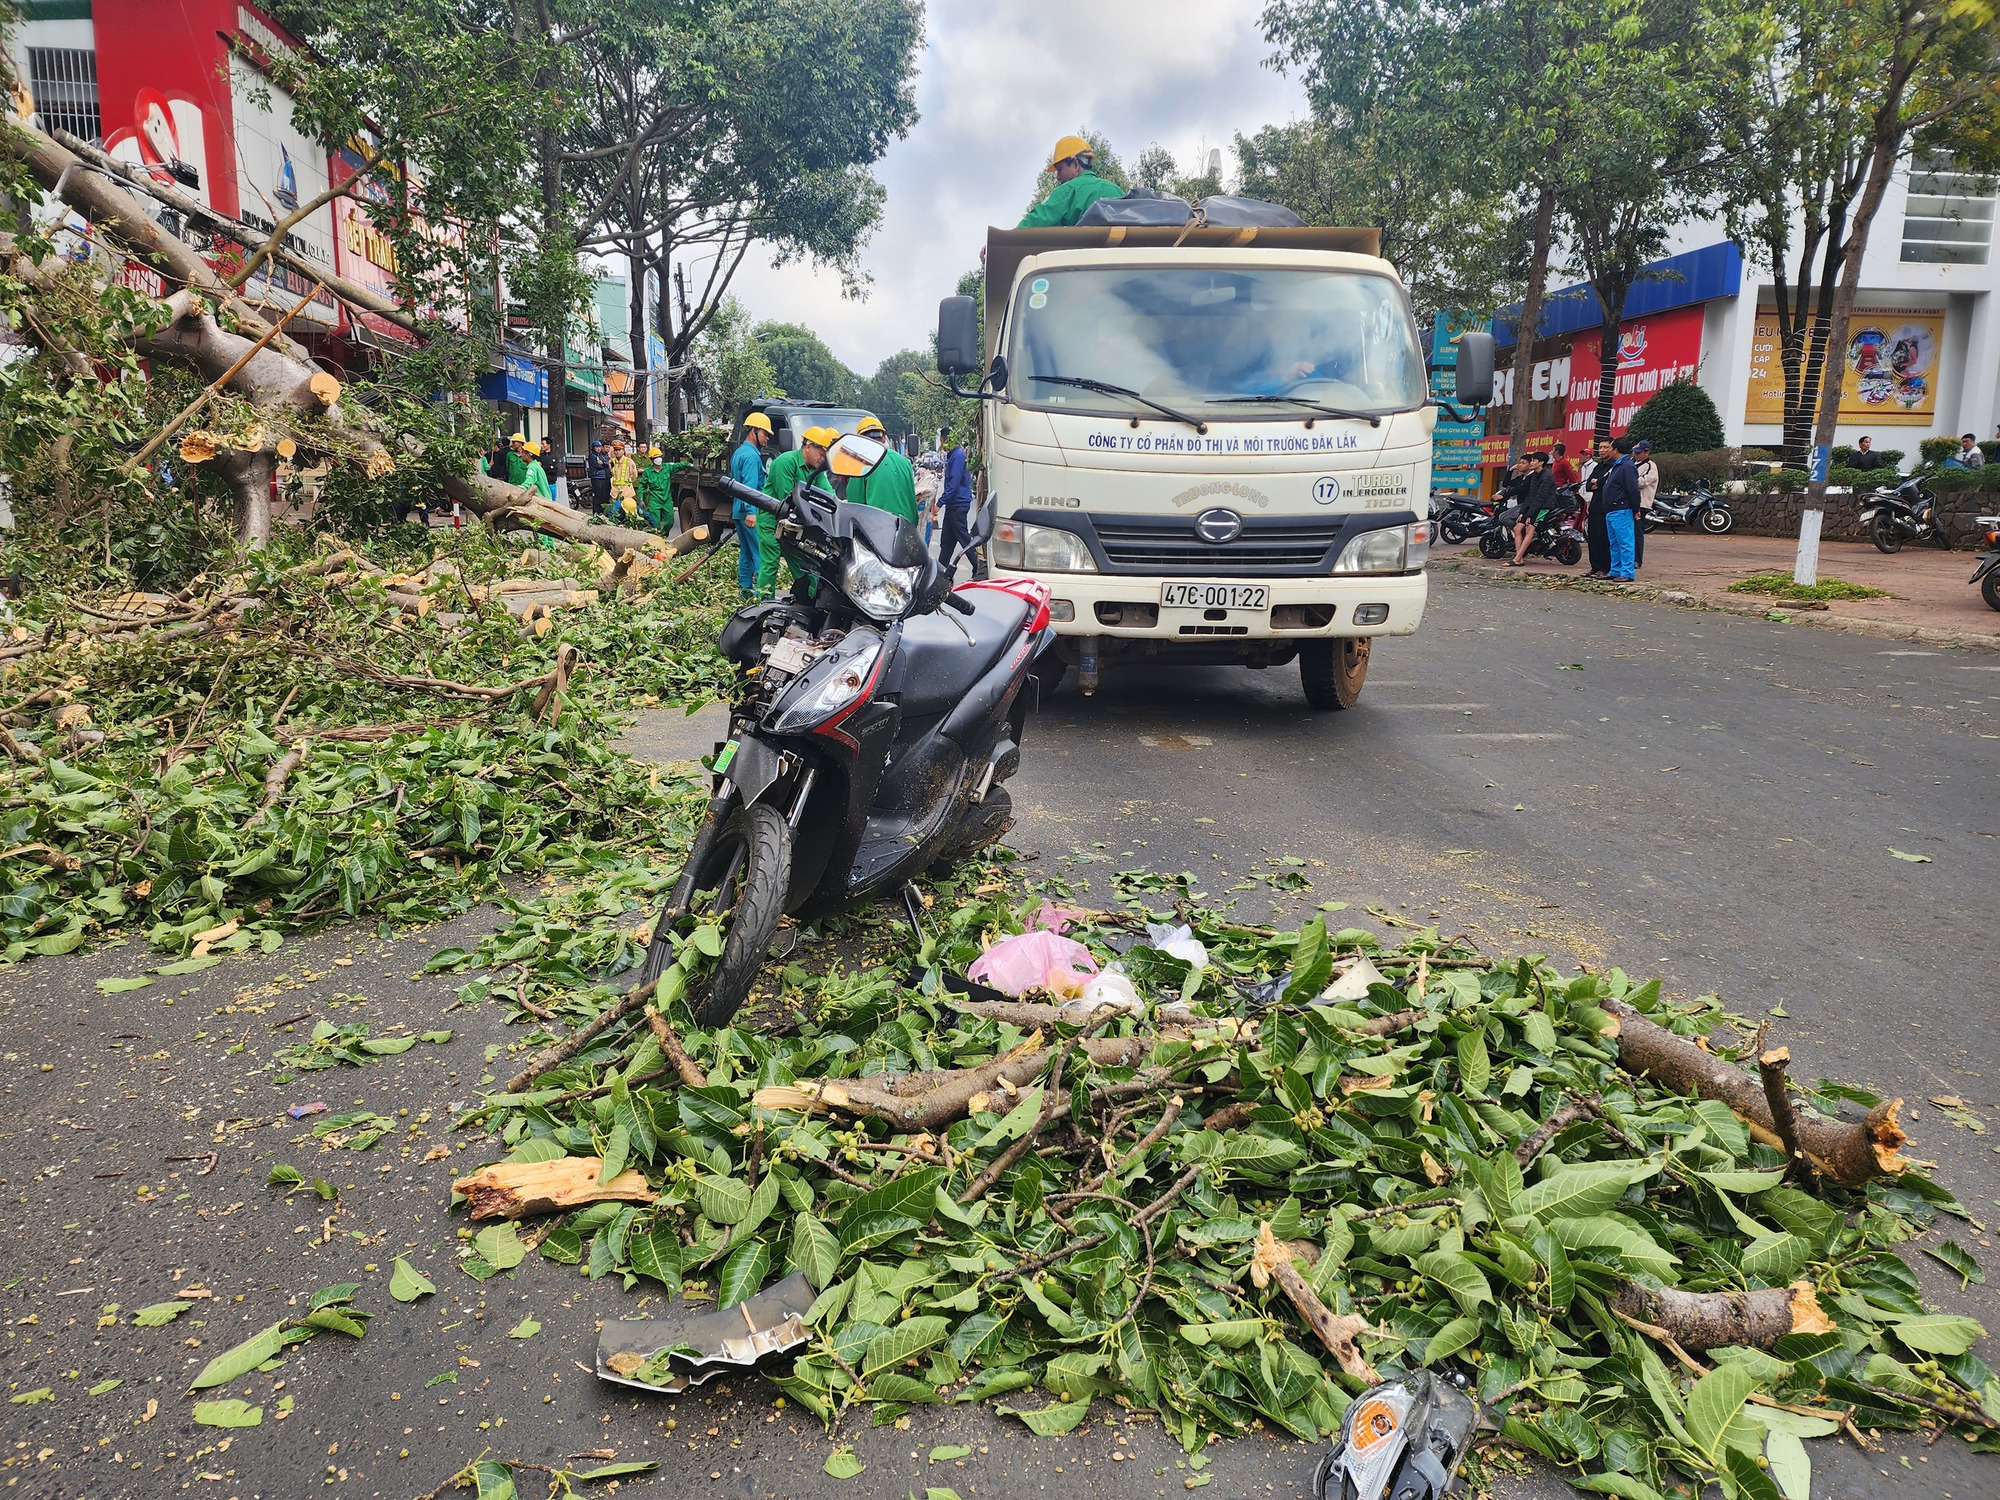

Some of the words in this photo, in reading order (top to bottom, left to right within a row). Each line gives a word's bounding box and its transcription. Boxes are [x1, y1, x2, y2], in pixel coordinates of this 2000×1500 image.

[1754, 324, 1774, 337] IÊU
[1532, 357, 1571, 401] EM
[1621, 373, 1636, 395] VUI
[1637, 369, 1659, 392] CHƠI
[1584, 410, 1596, 430] NH
[1088, 432, 1117, 448] CÔNG
[1120, 436, 1133, 450] TY
[1137, 432, 1152, 450] CỔ
[1155, 433, 1184, 451] PHẦN
[1187, 435, 1201, 451] ĐÔ
[1205, 439, 1223, 454] THỊ
[1226, 436, 1240, 452] VÀ
[1244, 436, 1263, 451] MÔI
[1267, 435, 1309, 451] TRƯỜNG
[1312, 432, 1333, 450] ĐẮK
[1337, 430, 1357, 449] LẮK
[1318, 483, 1335, 498] 17
[1352, 473, 1403, 497] TURBO
[1029, 495, 1081, 509] HINO
[1165, 585, 1265, 608] 47C-001.22
[1009, 641, 1031, 671] VISION
